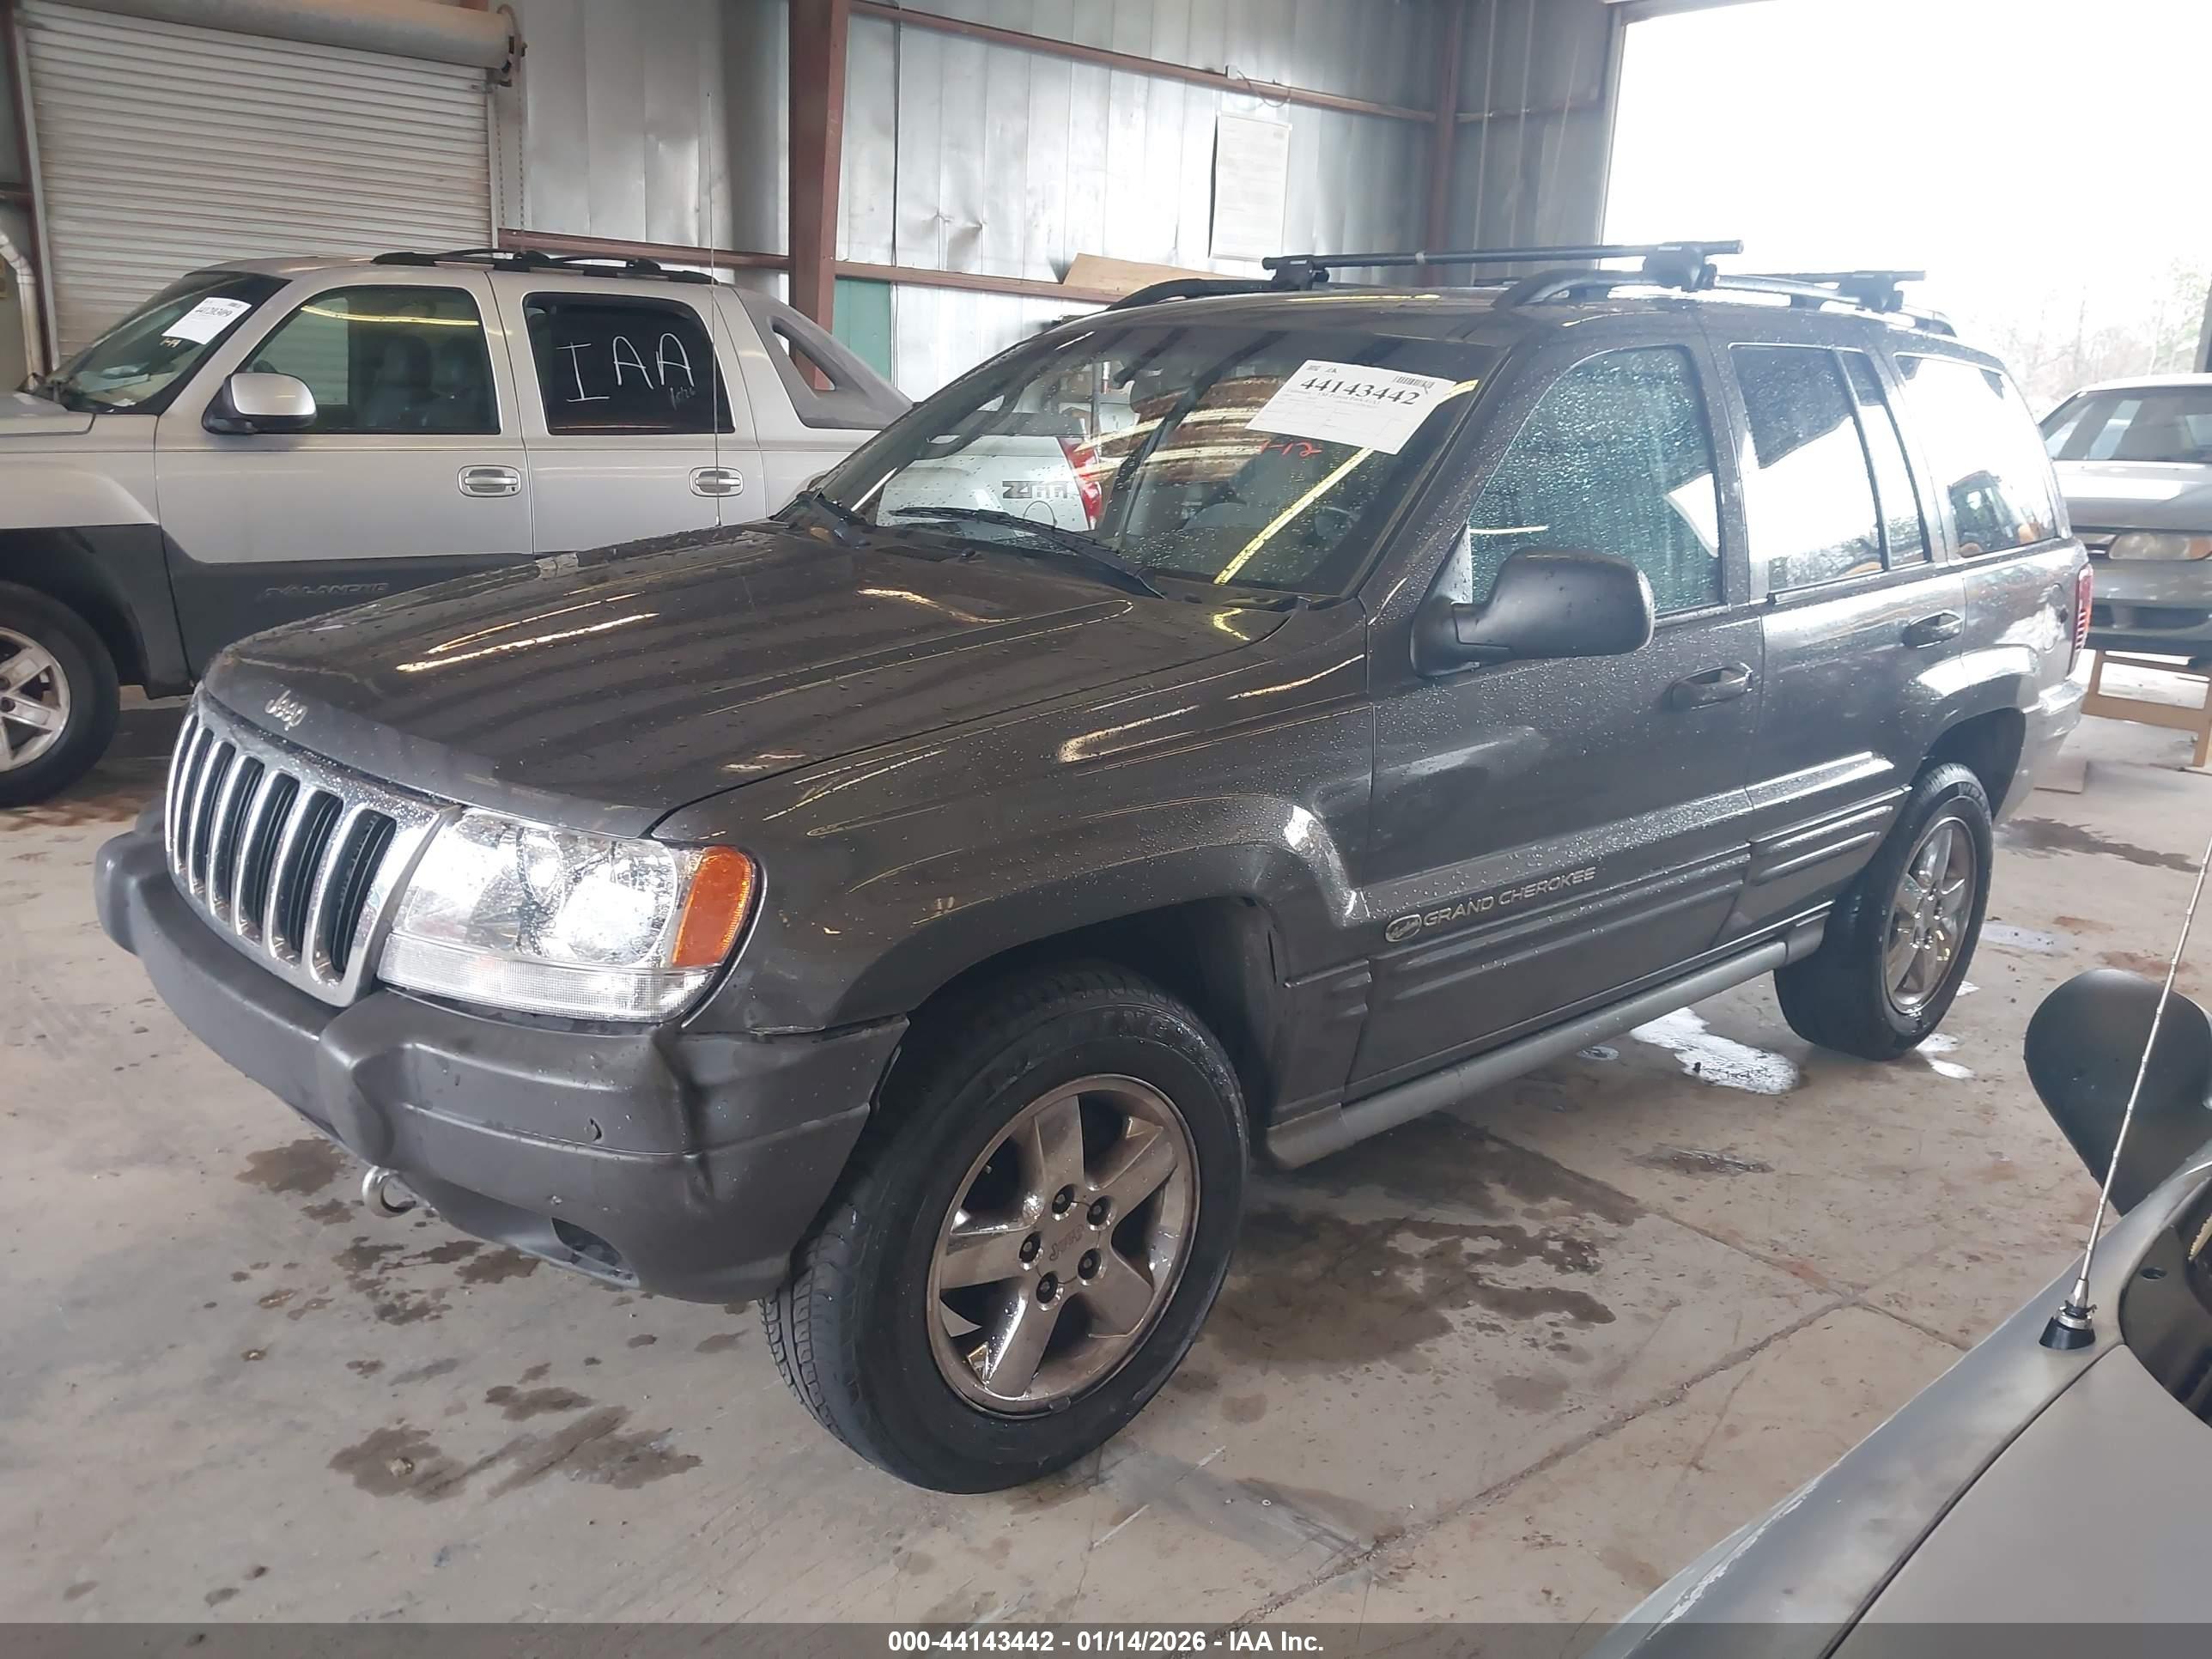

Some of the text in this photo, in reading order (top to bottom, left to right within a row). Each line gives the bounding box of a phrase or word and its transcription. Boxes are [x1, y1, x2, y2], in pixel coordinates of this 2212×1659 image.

[556, 332, 695, 402] IAA
[1299, 376, 1421, 405] 44143442
[264, 689, 308, 732] Jeep
[1423, 866, 1597, 927] GRAND CHEROKEE
